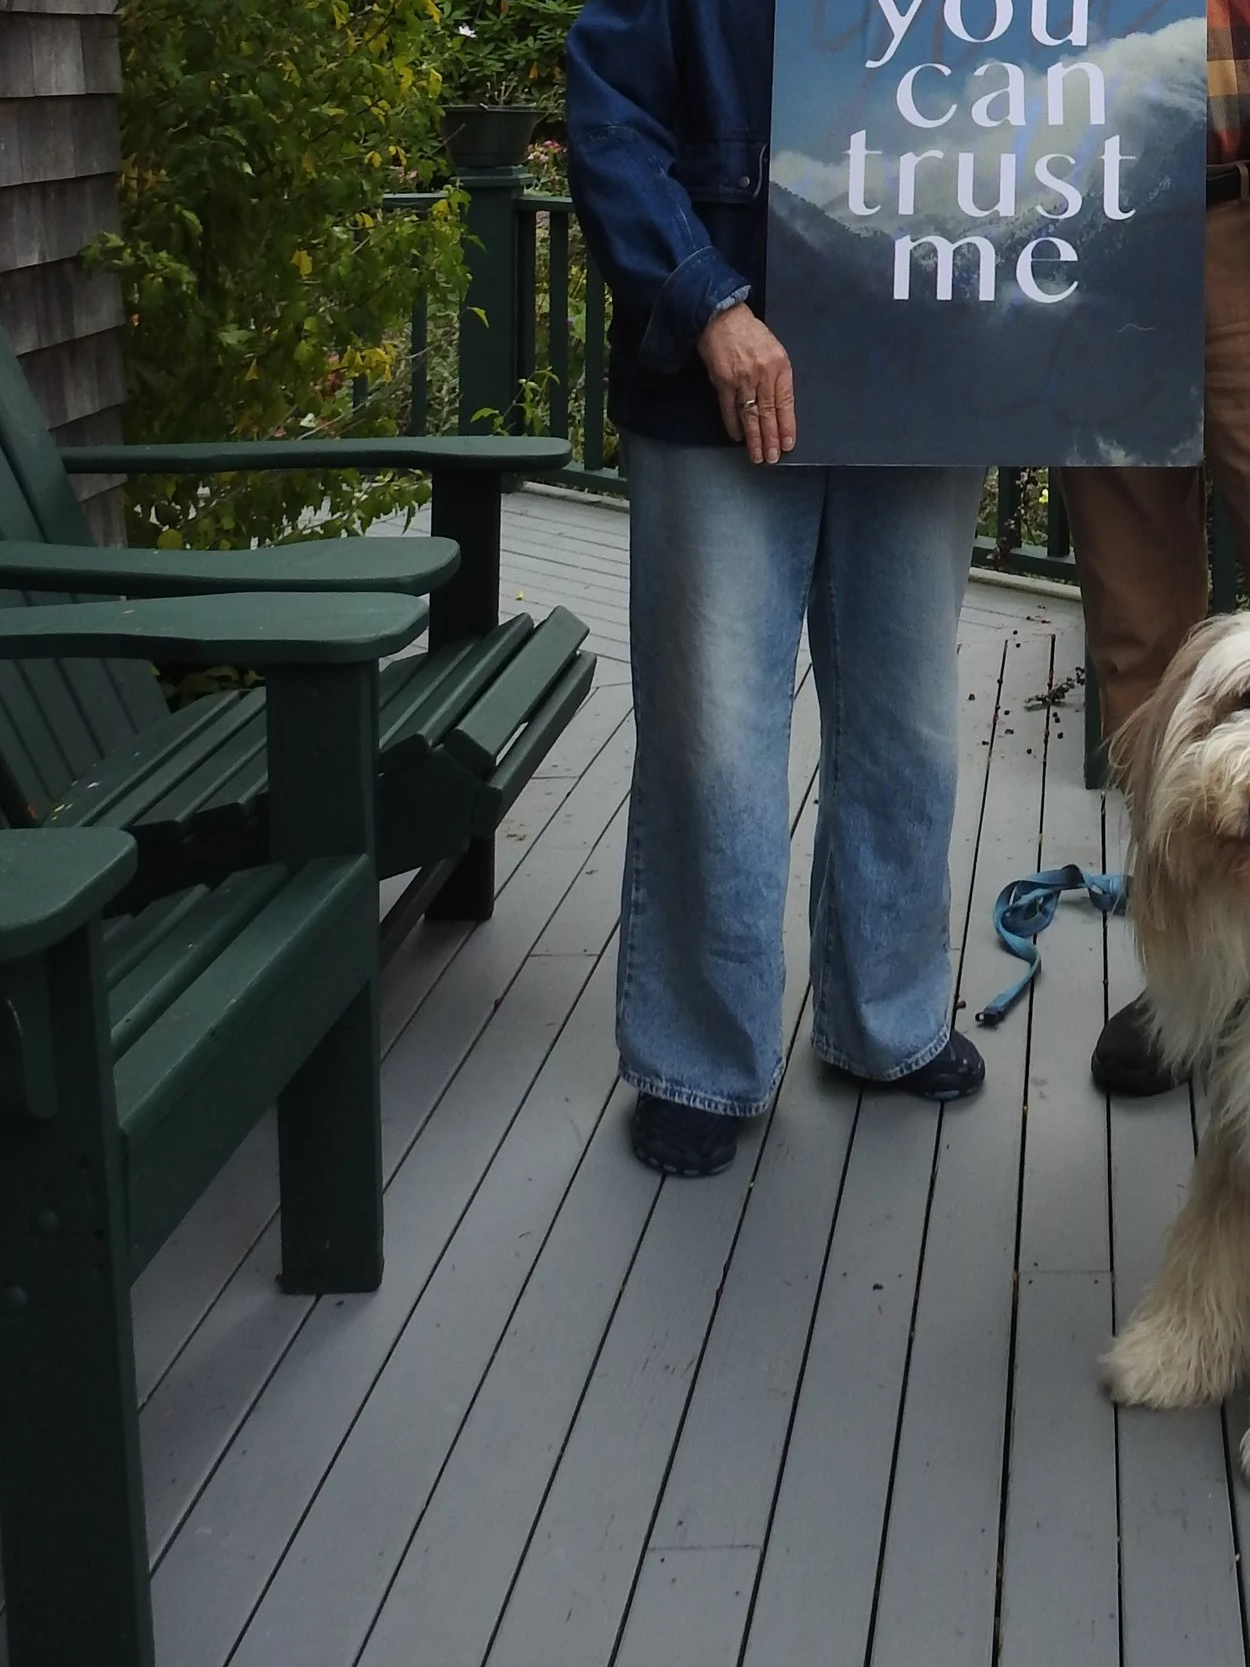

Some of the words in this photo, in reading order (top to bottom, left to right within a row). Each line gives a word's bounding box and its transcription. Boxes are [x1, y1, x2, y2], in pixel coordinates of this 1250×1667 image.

[896, 61, 1106, 129] can
[843, 129, 1137, 221] trust
[893, 234, 1079, 304] me
